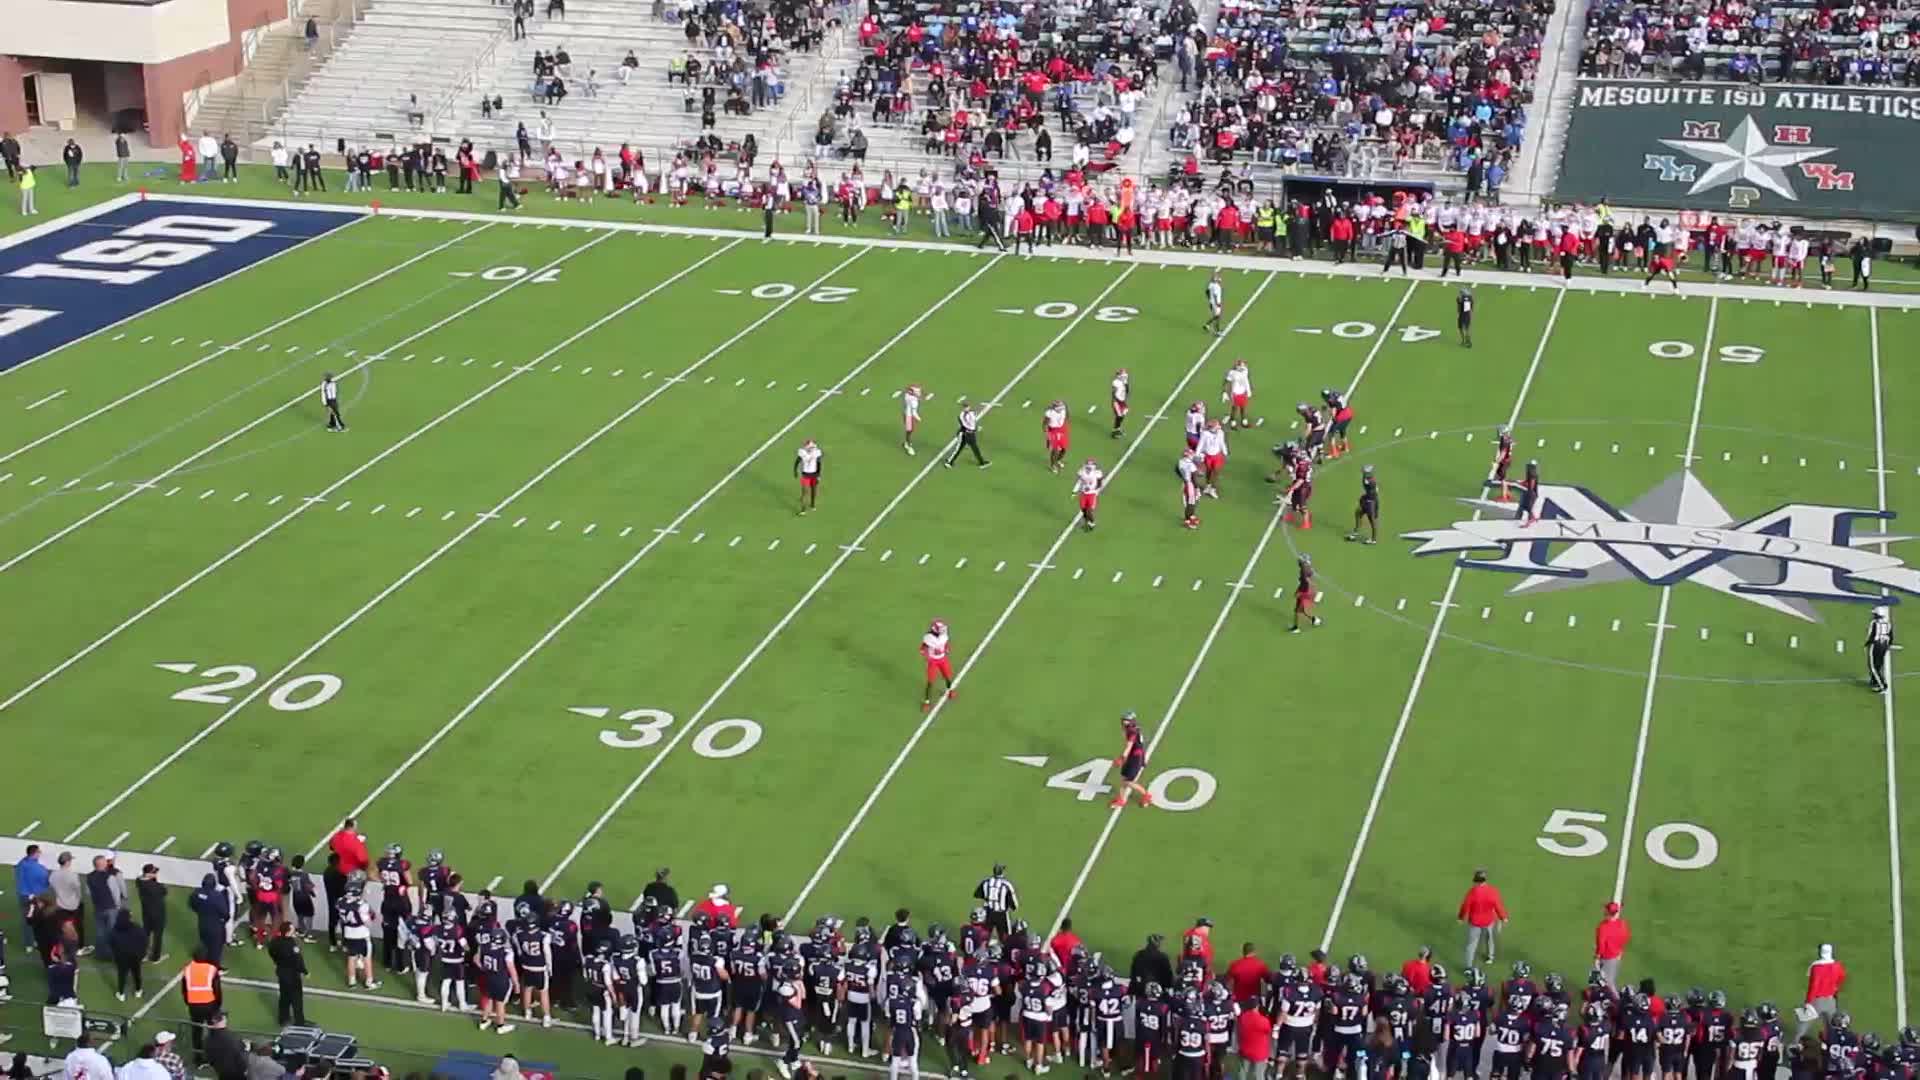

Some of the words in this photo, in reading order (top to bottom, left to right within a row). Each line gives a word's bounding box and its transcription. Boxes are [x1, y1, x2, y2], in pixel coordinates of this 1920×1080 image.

[1580, 86, 1714, 106] MESQUITE
[1724, 90, 1766, 107] ISD
[1775, 91, 1920, 120] ATHLETICS
[1683, 120, 1720, 139] M
[1774, 125, 1811, 144] H
[1643, 154, 1697, 182] NM
[1798, 162, 1855, 190] WM
[1, 215, 277, 284] ISD
[735, 283, 858, 302] 20
[1034, 302, 1140, 322] 30
[1331, 321, 1442, 343] 40
[1648, 340, 1766, 363] 50
[1555, 519, 1801, 555] MISD
[171, 664, 344, 711] 20
[600, 708, 763, 759] 30
[1045, 756, 1217, 811] 40
[1536, 808, 1719, 869] 50
[660, 960, 673, 974] 5
[895, 1009, 907, 1024] 8
[1099, 998, 1121, 1016] 42
[1453, 1024, 1475, 1041] 30
[1499, 1027, 1519, 1045] 70
[1631, 1028, 1648, 1044] 14
[1540, 1037, 1564, 1057] 75
